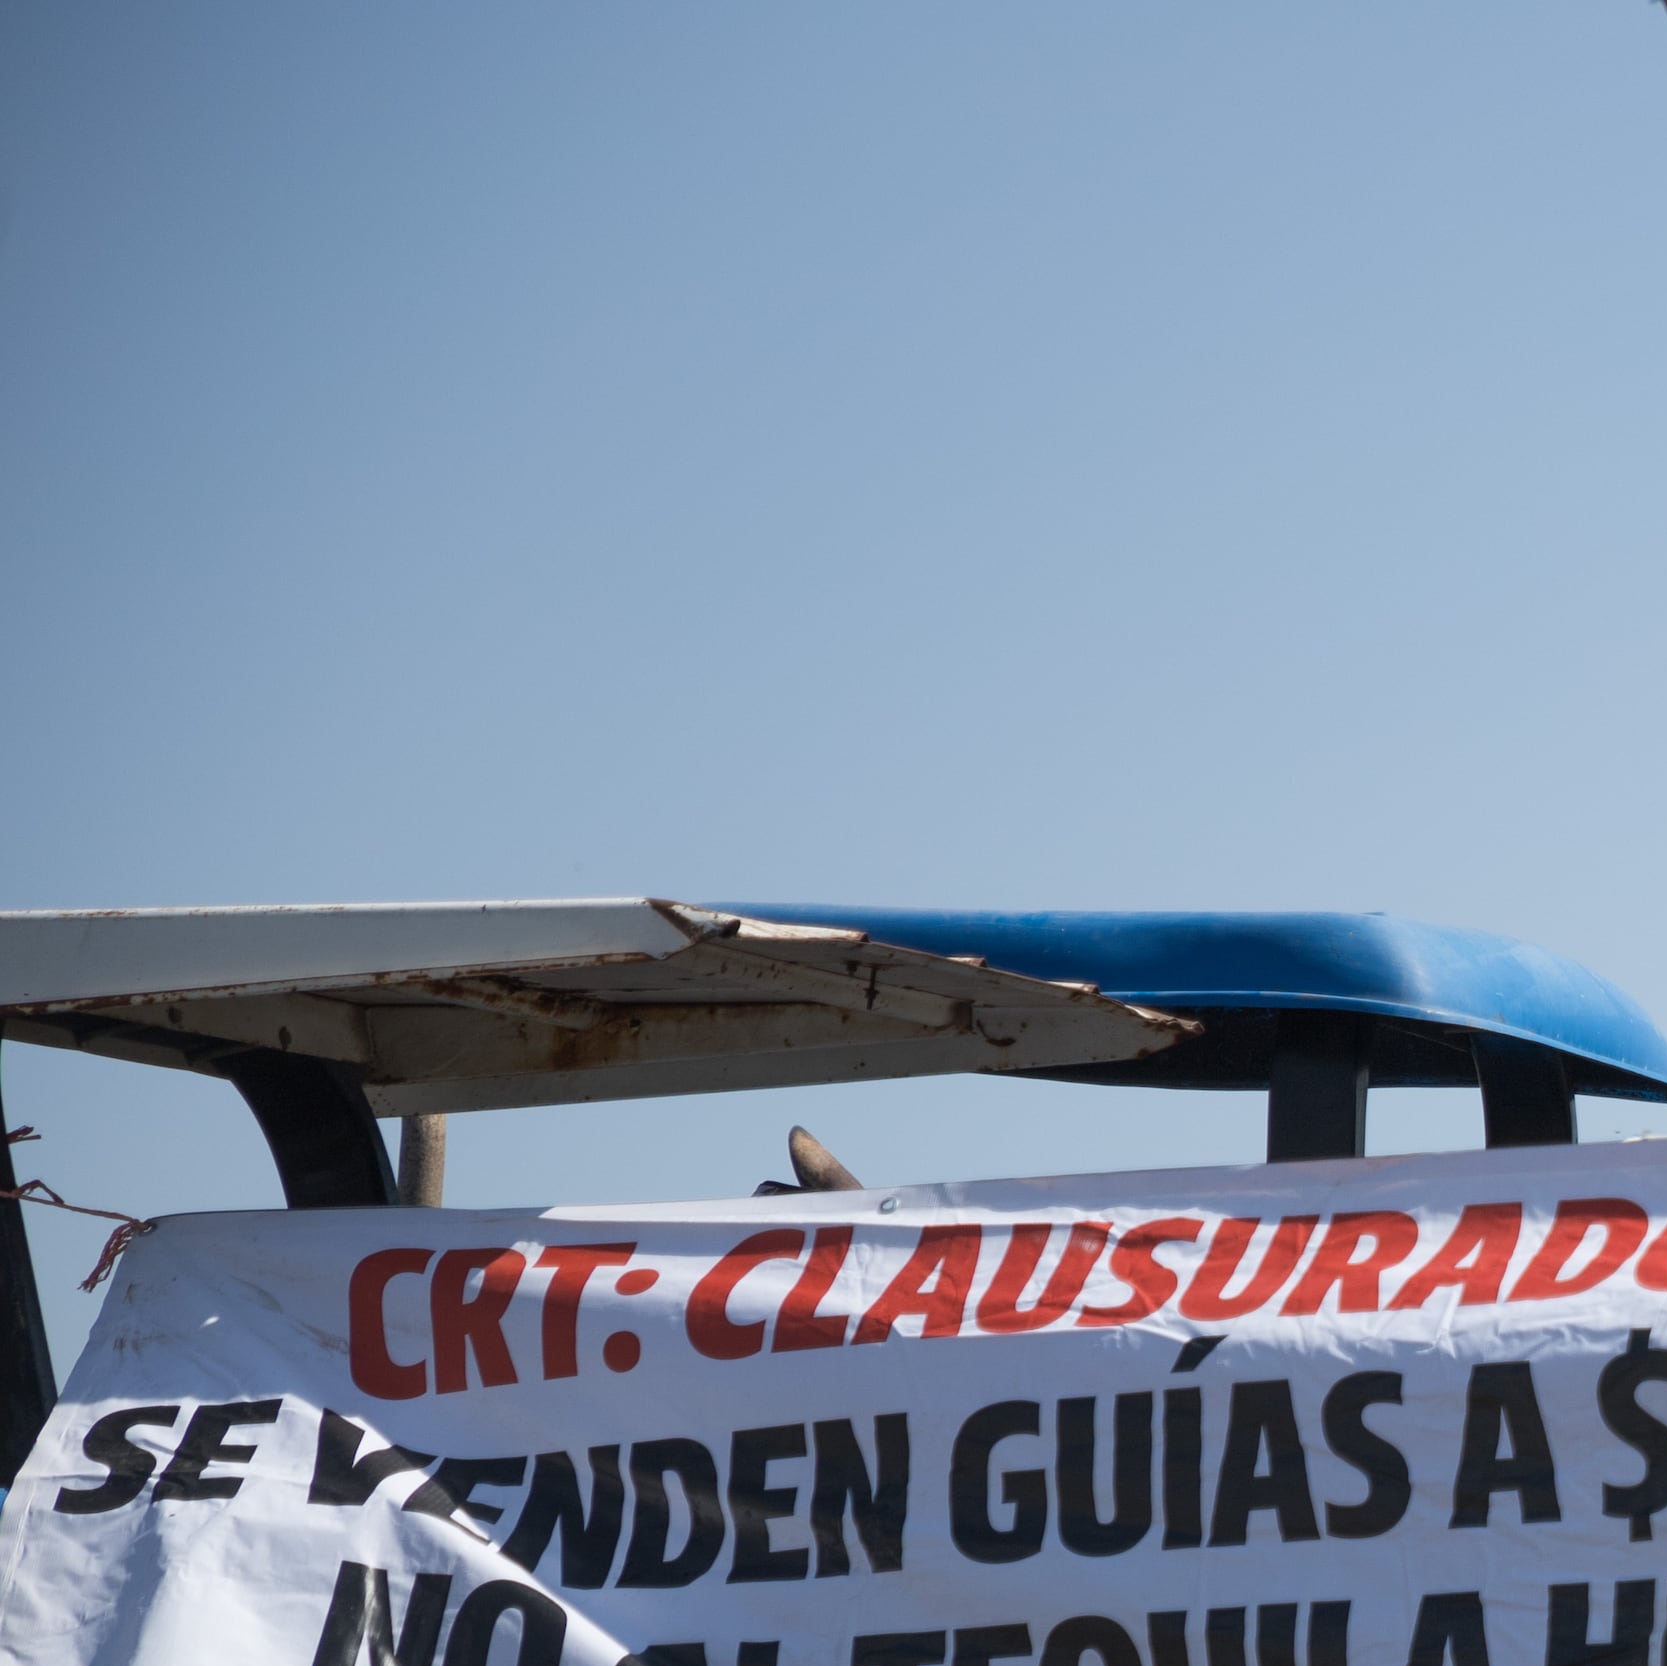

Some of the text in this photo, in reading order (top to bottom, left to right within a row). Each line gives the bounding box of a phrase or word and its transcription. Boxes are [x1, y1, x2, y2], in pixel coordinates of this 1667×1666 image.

[349, 1243, 660, 1400] CRT:
[53, 1399, 284, 1515] SE
[306, 1407, 910, 1590] VENDEN
[947, 1335, 1412, 1565] GUÍAS
[1447, 1361, 1562, 1529] A
